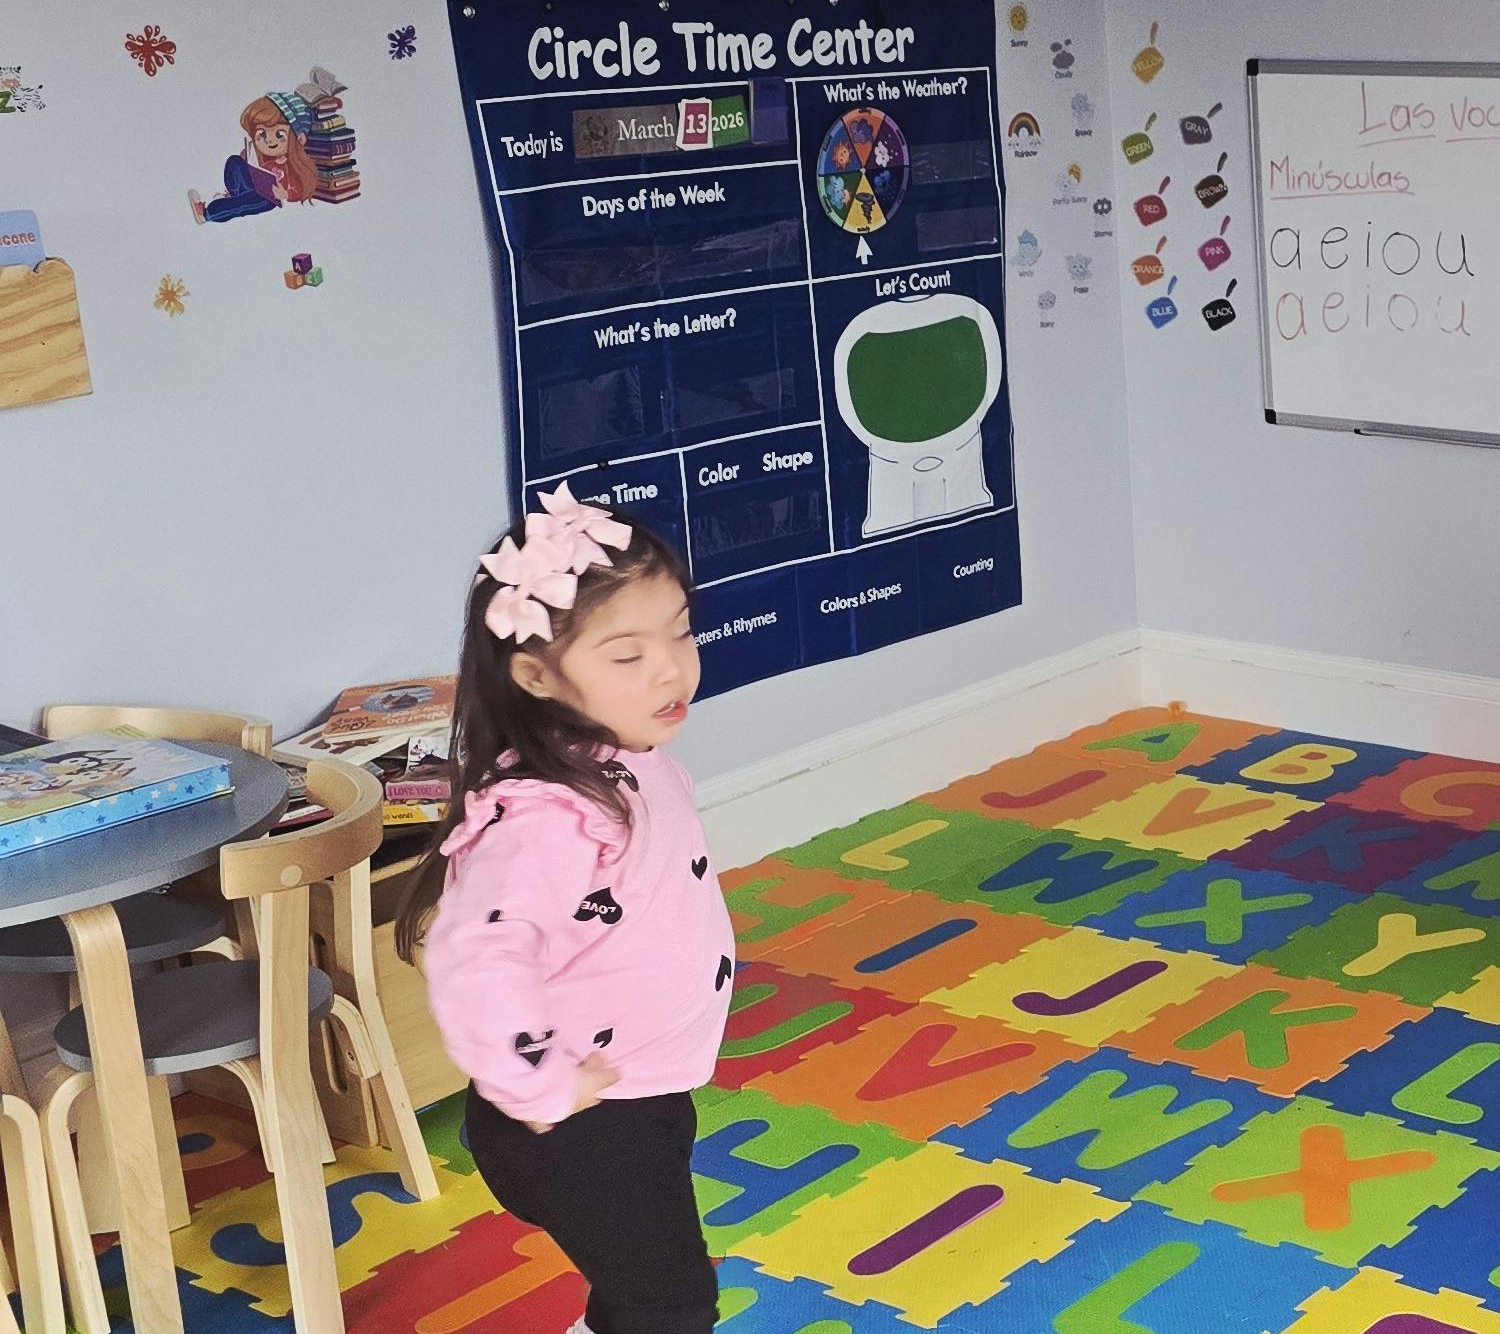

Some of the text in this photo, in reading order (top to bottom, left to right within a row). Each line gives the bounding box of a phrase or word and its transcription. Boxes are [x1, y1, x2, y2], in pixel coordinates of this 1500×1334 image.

[528, 17, 915, 80] Circle Time Center
[823, 76, 968, 103] What's the Weather?
[1359, 81, 1436, 135] Las
[617, 115, 674, 142] March
[685, 113, 708, 135] 13
[712, 111, 745, 131] 2026
[1184, 120, 1209, 134] GRAY
[501, 130, 563, 159] Today is
[1124, 140, 1151, 157] GREEN
[1196, 184, 1227, 200] BROWN
[1269, 155, 1411, 192] Minúsculas
[582, 182, 726, 219] Days of the Week
[1142, 203, 1160, 213] RED
[1131, 264, 1165, 275] ORANGE
[1205, 245, 1225, 257] PINK
[875, 270, 952, 298] Let's Count
[594, 308, 737, 349] What's the Letter?
[1151, 305, 1174, 317] BLUE
[1205, 306, 1233, 318] BLACK
[698, 450, 813, 487] Color Shape
[613, 483, 658, 505] Time
[953, 556, 994, 580] Counting
[820, 582, 902, 614] Colors & Shapes
[694, 610, 777, 647] etters & Rhymes
[1082, 723, 1201, 762] A
[1239, 743, 1358, 785] B
[393, 785, 415, 796] LOVE
[417, 785, 433, 796] YOU
[980, 769, 1108, 809] J
[1142, 786, 1275, 836] V
[840, 819, 950, 871] L
[1274, 816, 1419, 872] K
[977, 842, 1160, 904] W
[1134, 878, 1314, 944] X
[853, 918, 978, 974] I
[1341, 913, 1487, 977] Y
[1011, 960, 1168, 1016] J
[1173, 989, 1358, 1069] K
[855, 1023, 1036, 1102] V
[1006, 1069, 1234, 1170] W
[1210, 1124, 1437, 1232] X
[847, 1183, 1005, 1275] I
